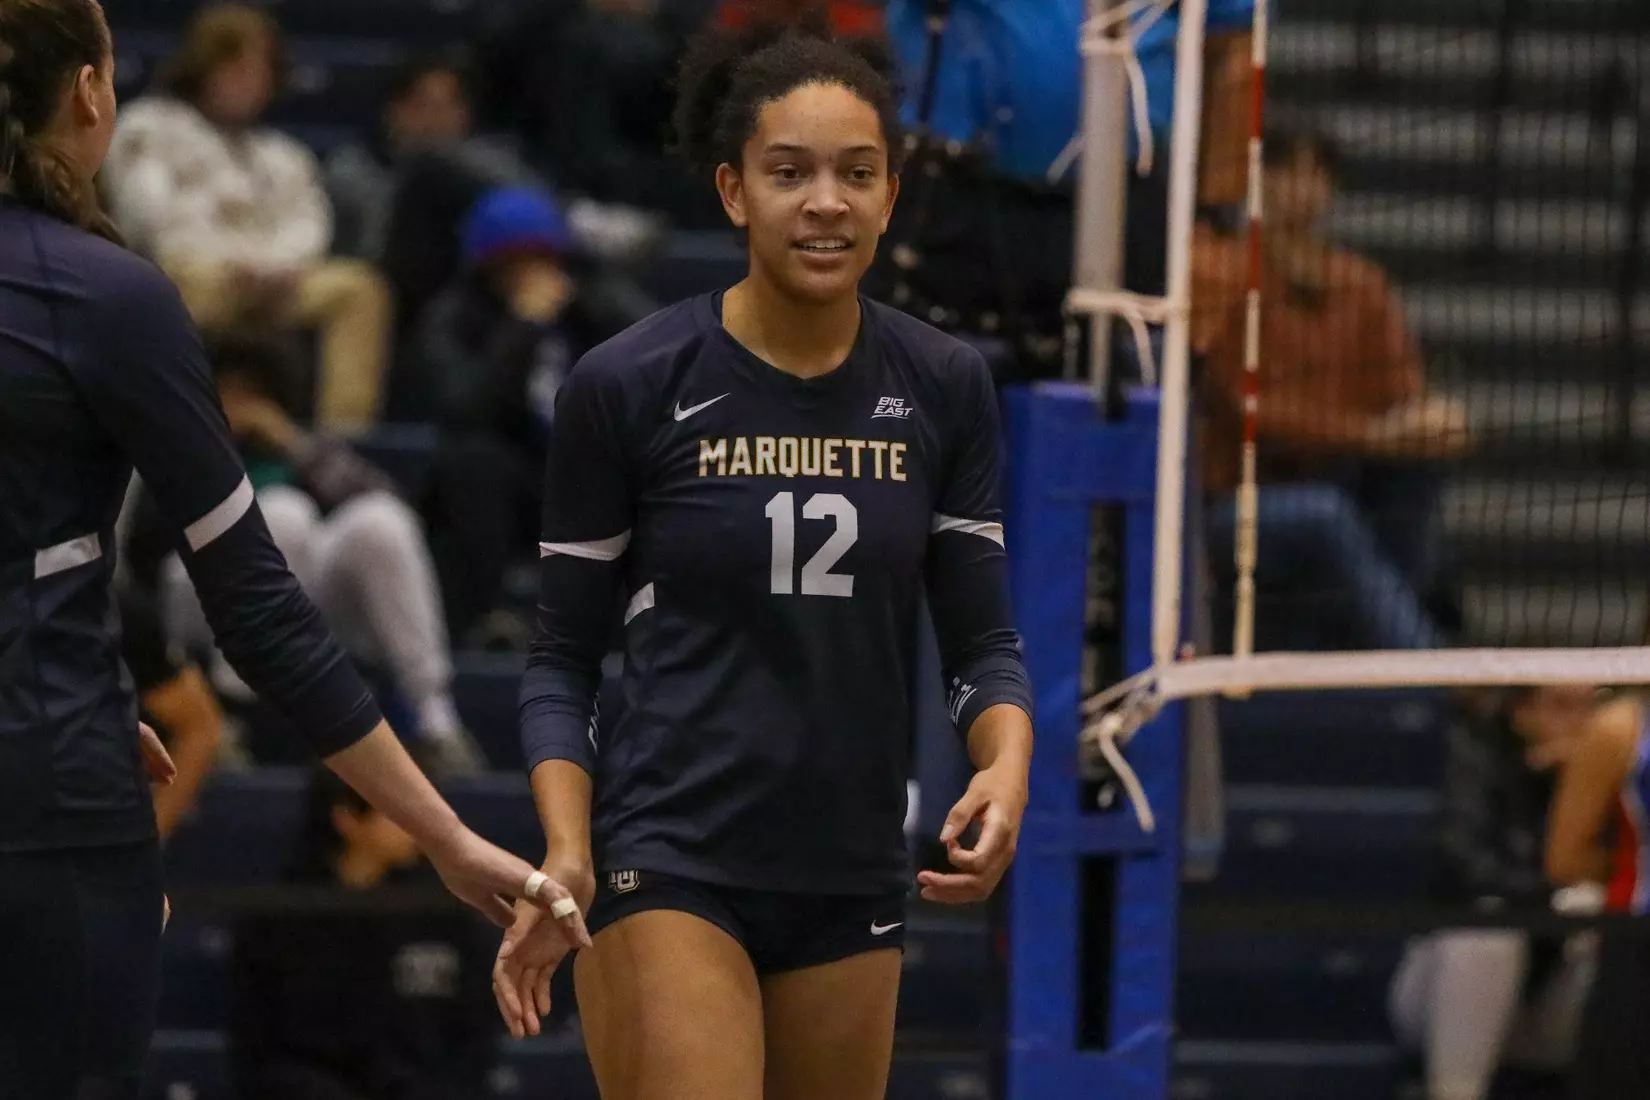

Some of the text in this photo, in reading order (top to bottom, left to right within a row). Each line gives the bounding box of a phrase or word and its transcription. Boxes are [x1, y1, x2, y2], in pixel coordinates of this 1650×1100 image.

[873, 405, 914, 417] EAST
[878, 396, 905, 407] BIG
[698, 436, 907, 481] MARQUETTE
[765, 491, 859, 598] 12
